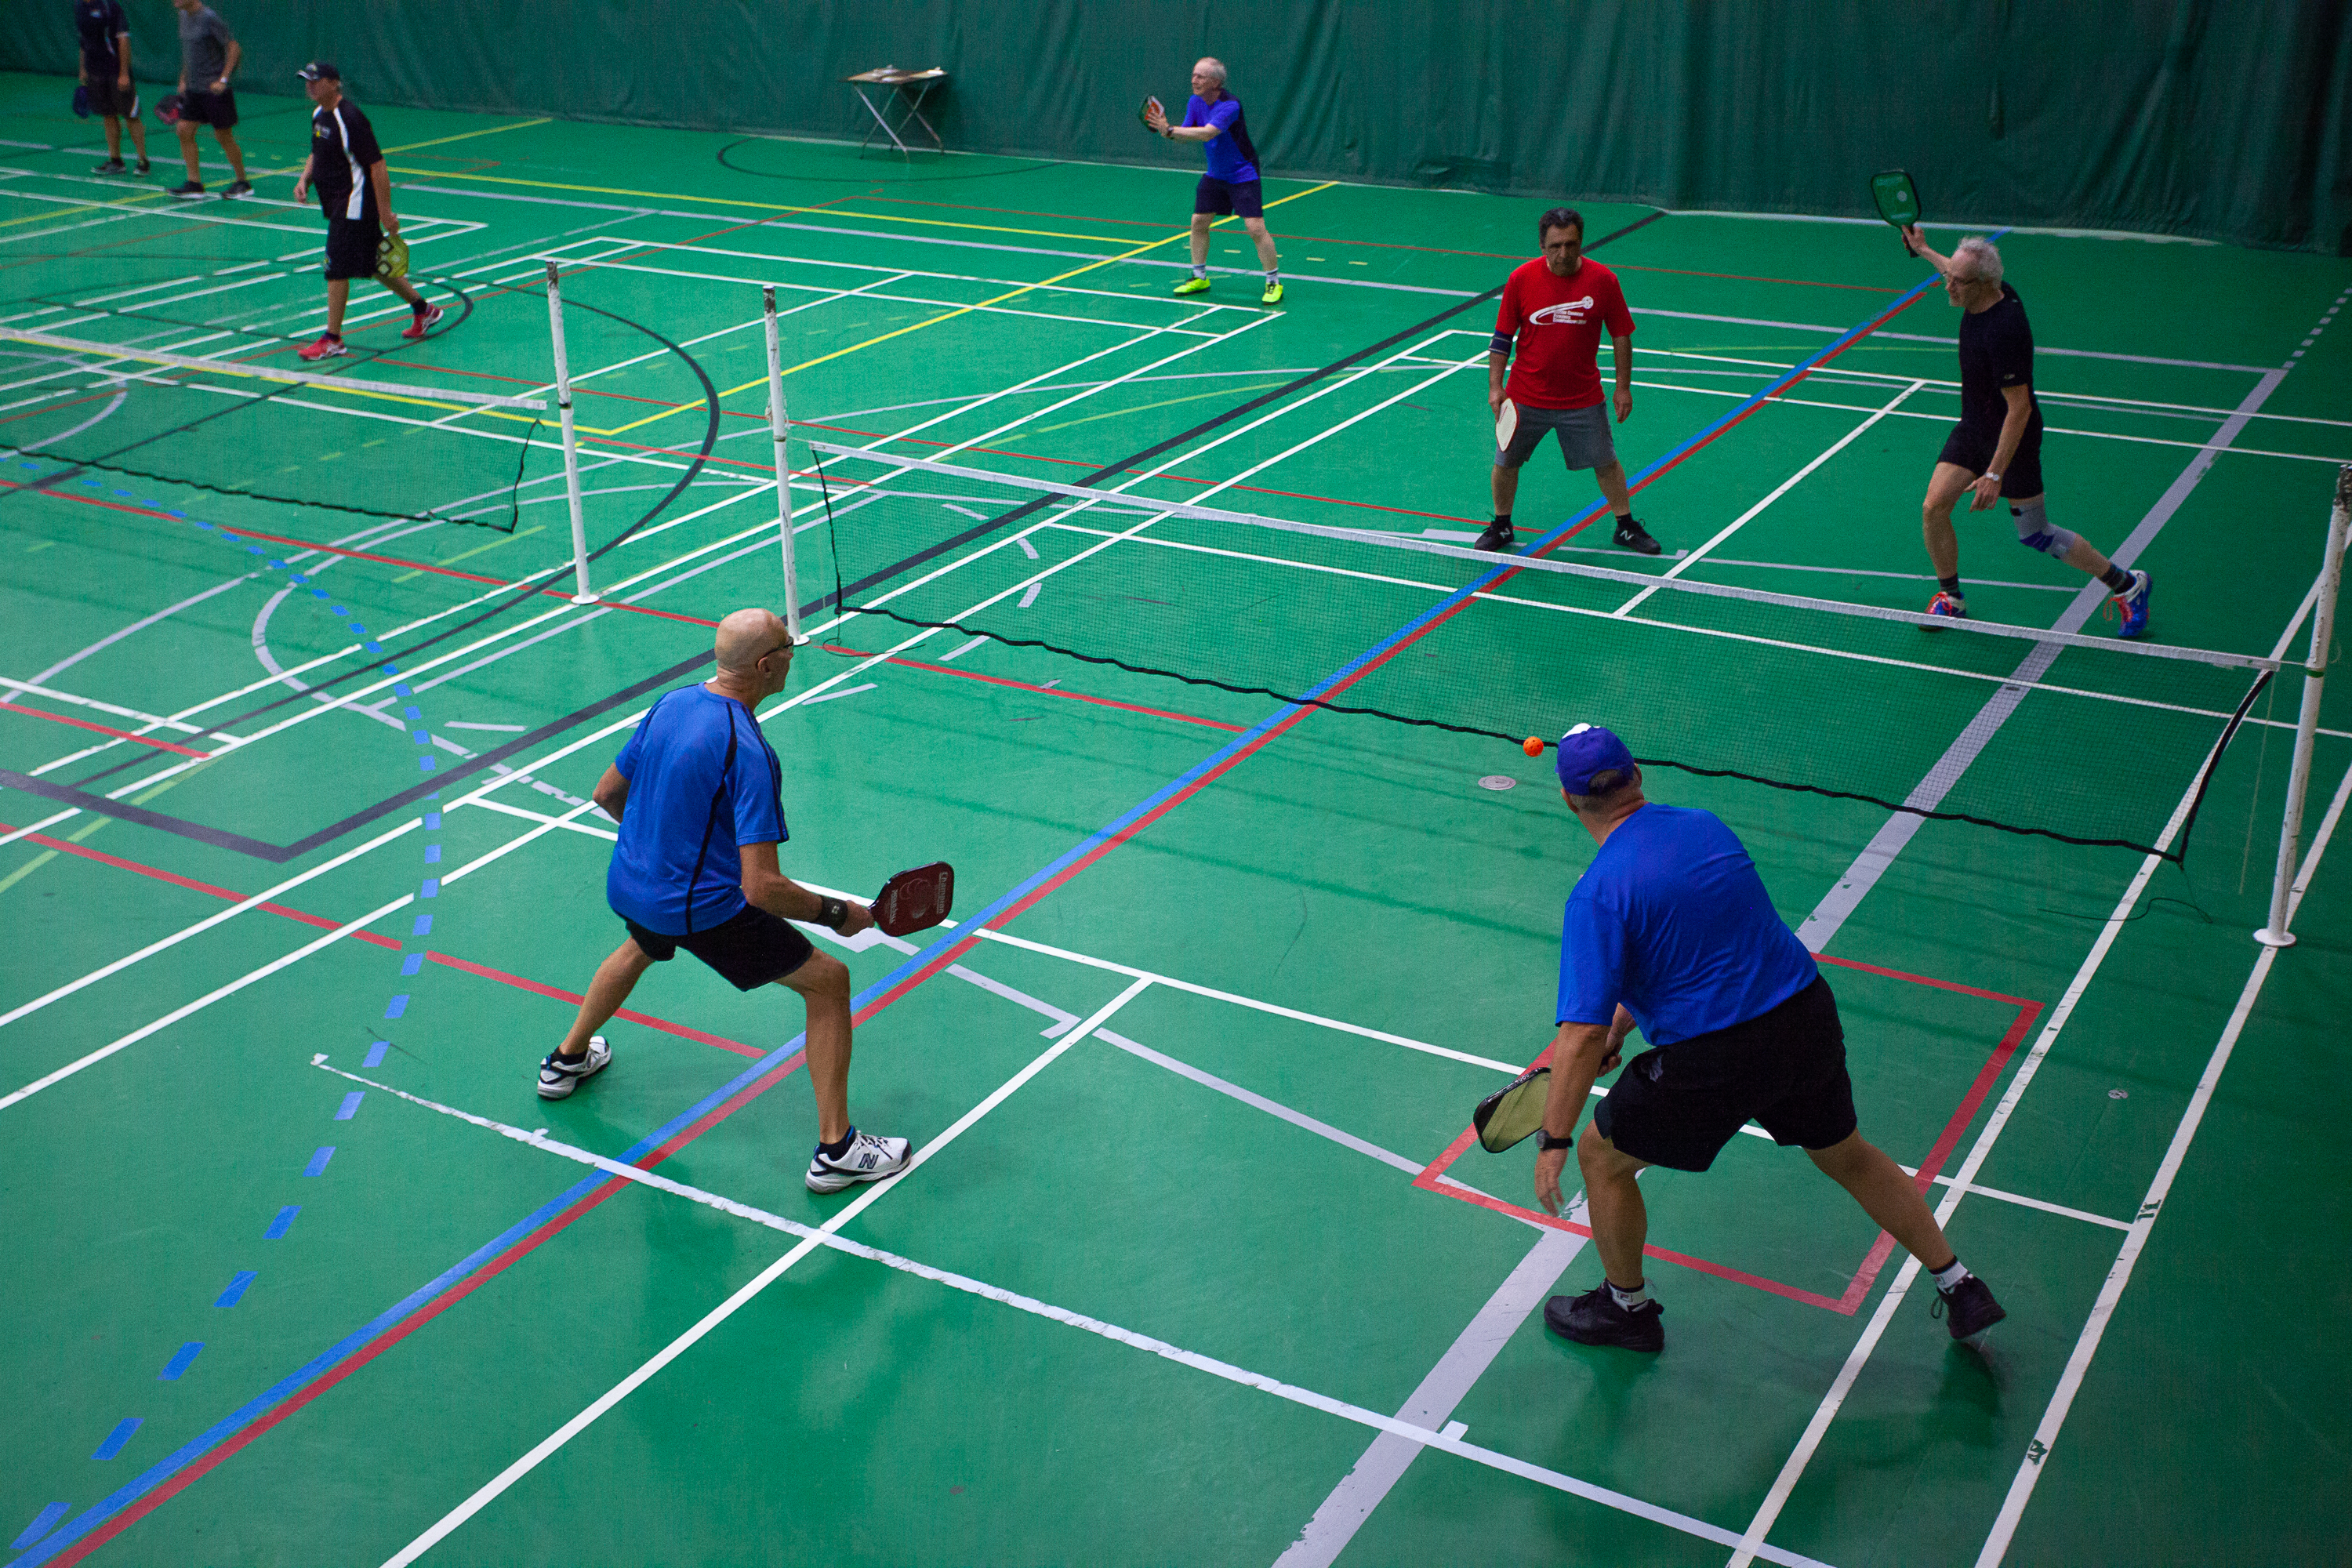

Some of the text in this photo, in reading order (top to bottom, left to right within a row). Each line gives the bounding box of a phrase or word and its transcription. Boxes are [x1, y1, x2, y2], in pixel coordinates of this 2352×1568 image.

[1620, 529, 1635, 542] N
[938, 872, 949, 914] Champion
[858, 1152, 879, 1170] N
